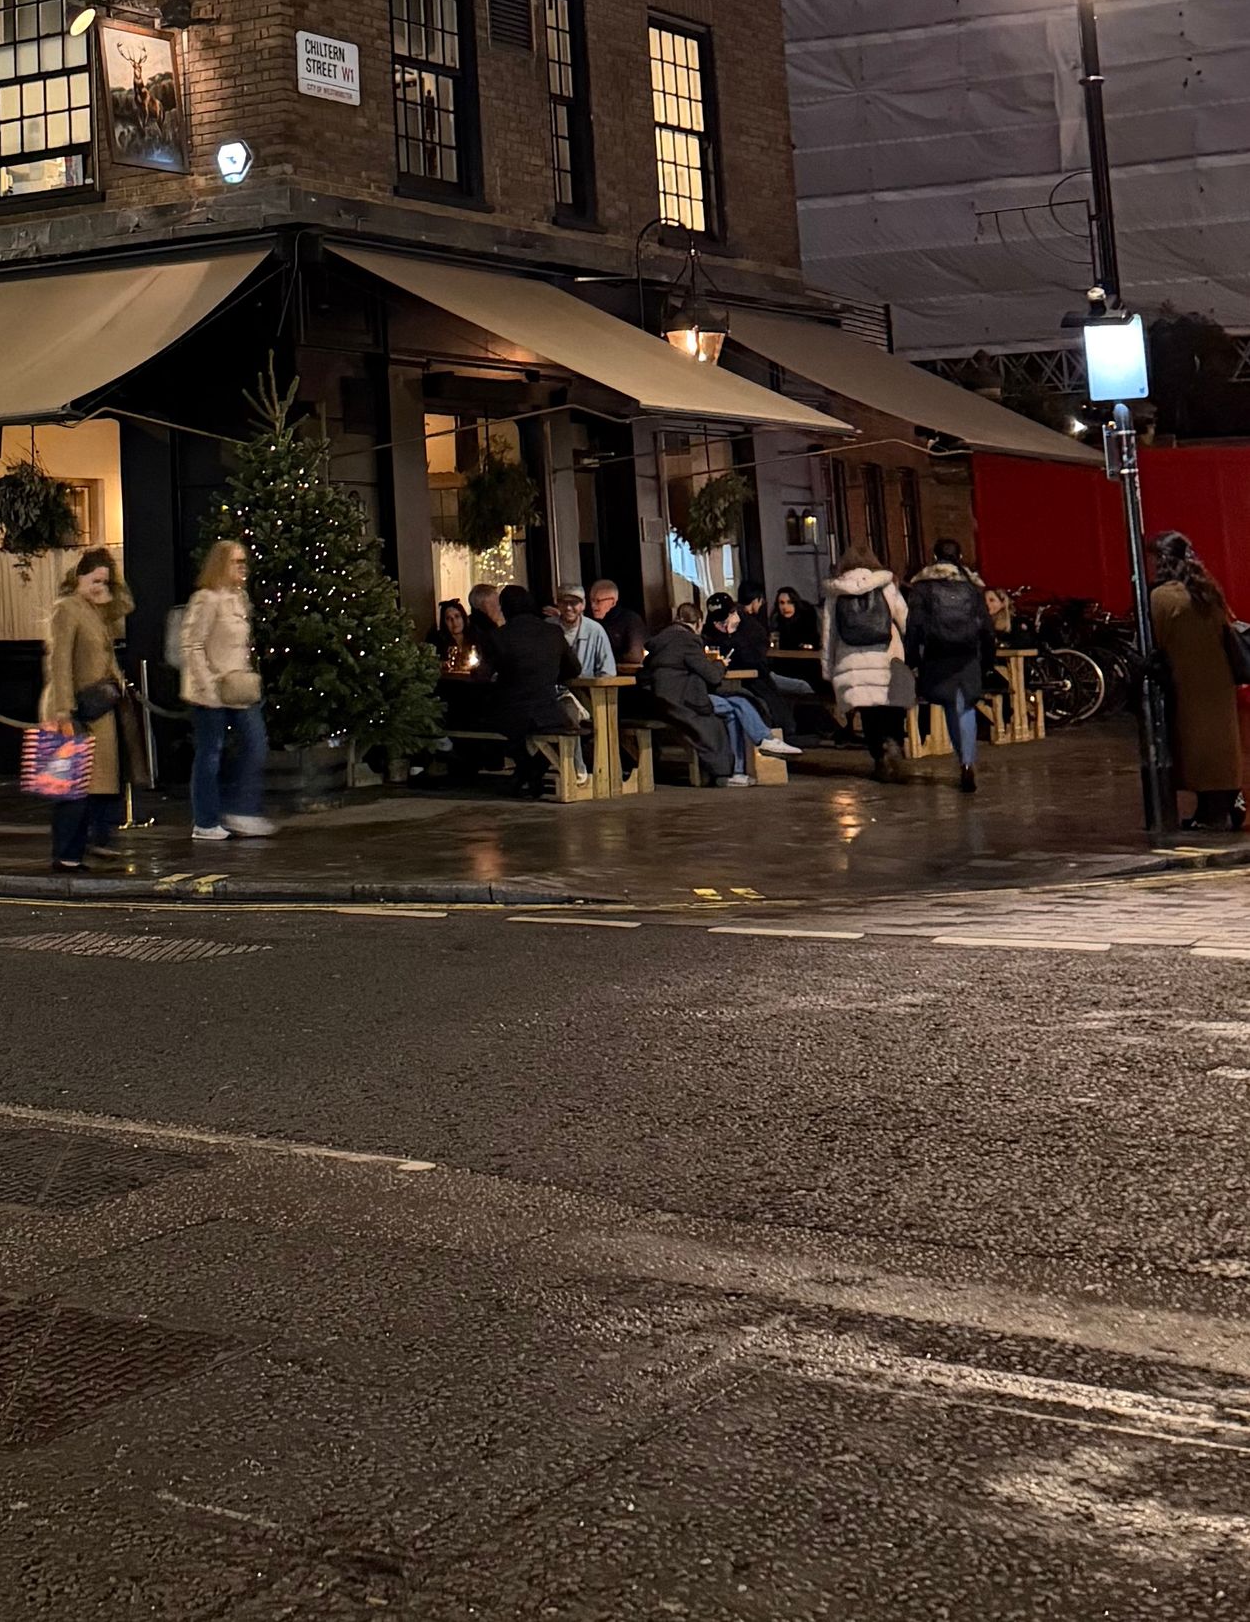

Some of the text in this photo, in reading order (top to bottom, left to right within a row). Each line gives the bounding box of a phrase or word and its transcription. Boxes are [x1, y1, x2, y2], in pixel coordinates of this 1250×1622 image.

[305, 39, 345, 62] CHILTERN
[306, 57, 354, 83] STREET W1
